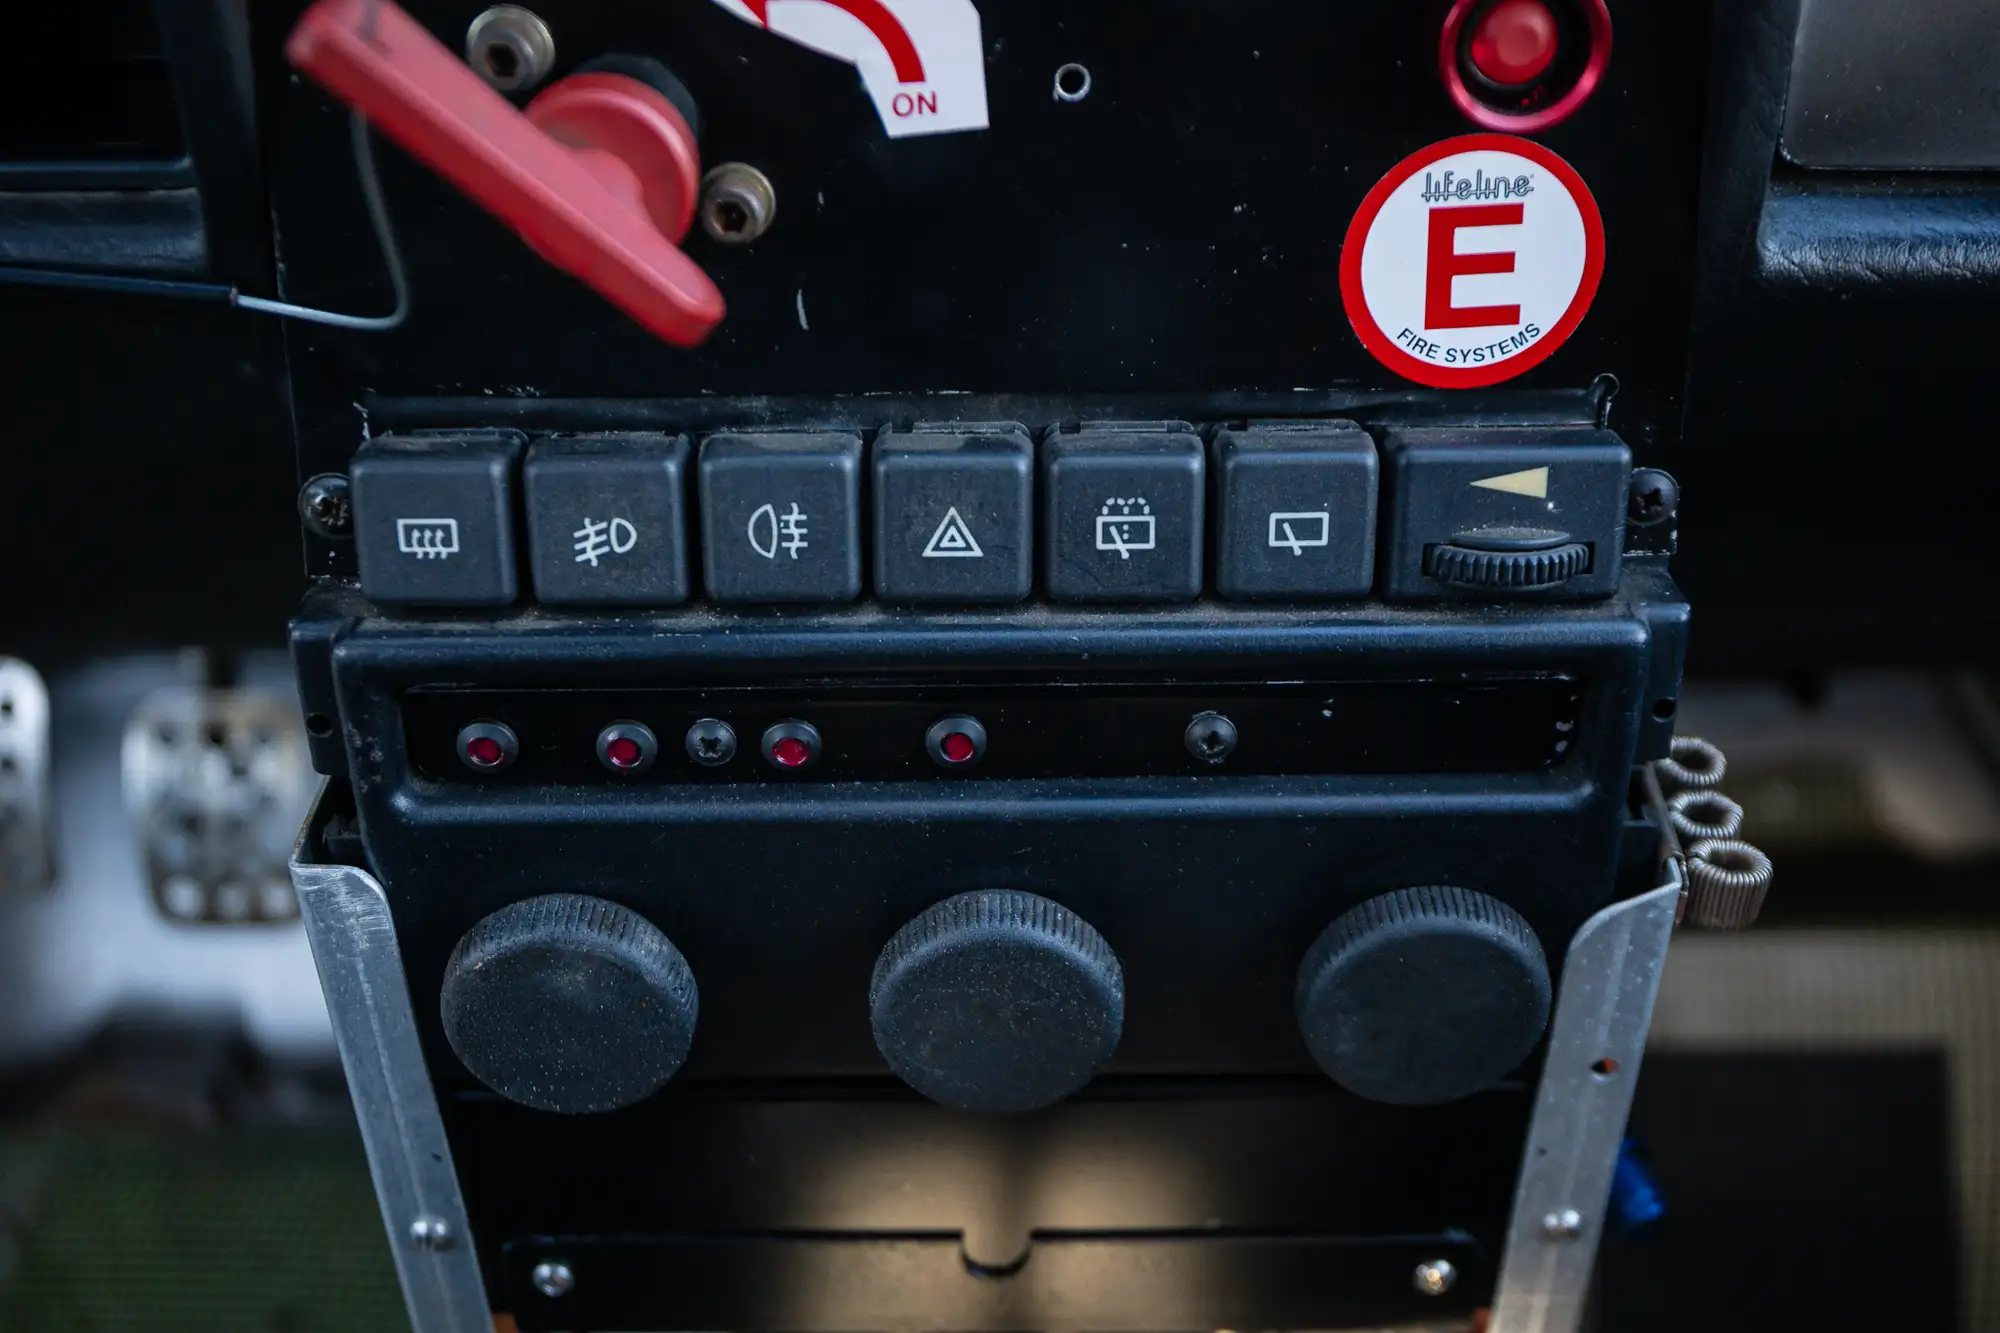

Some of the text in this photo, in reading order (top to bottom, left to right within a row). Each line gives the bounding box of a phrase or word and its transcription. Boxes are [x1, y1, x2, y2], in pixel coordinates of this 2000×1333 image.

[892, 91, 937, 117] ON
[1424, 202, 1525, 330] E
[1397, 323, 1541, 363] FIRE SYSTEMS
